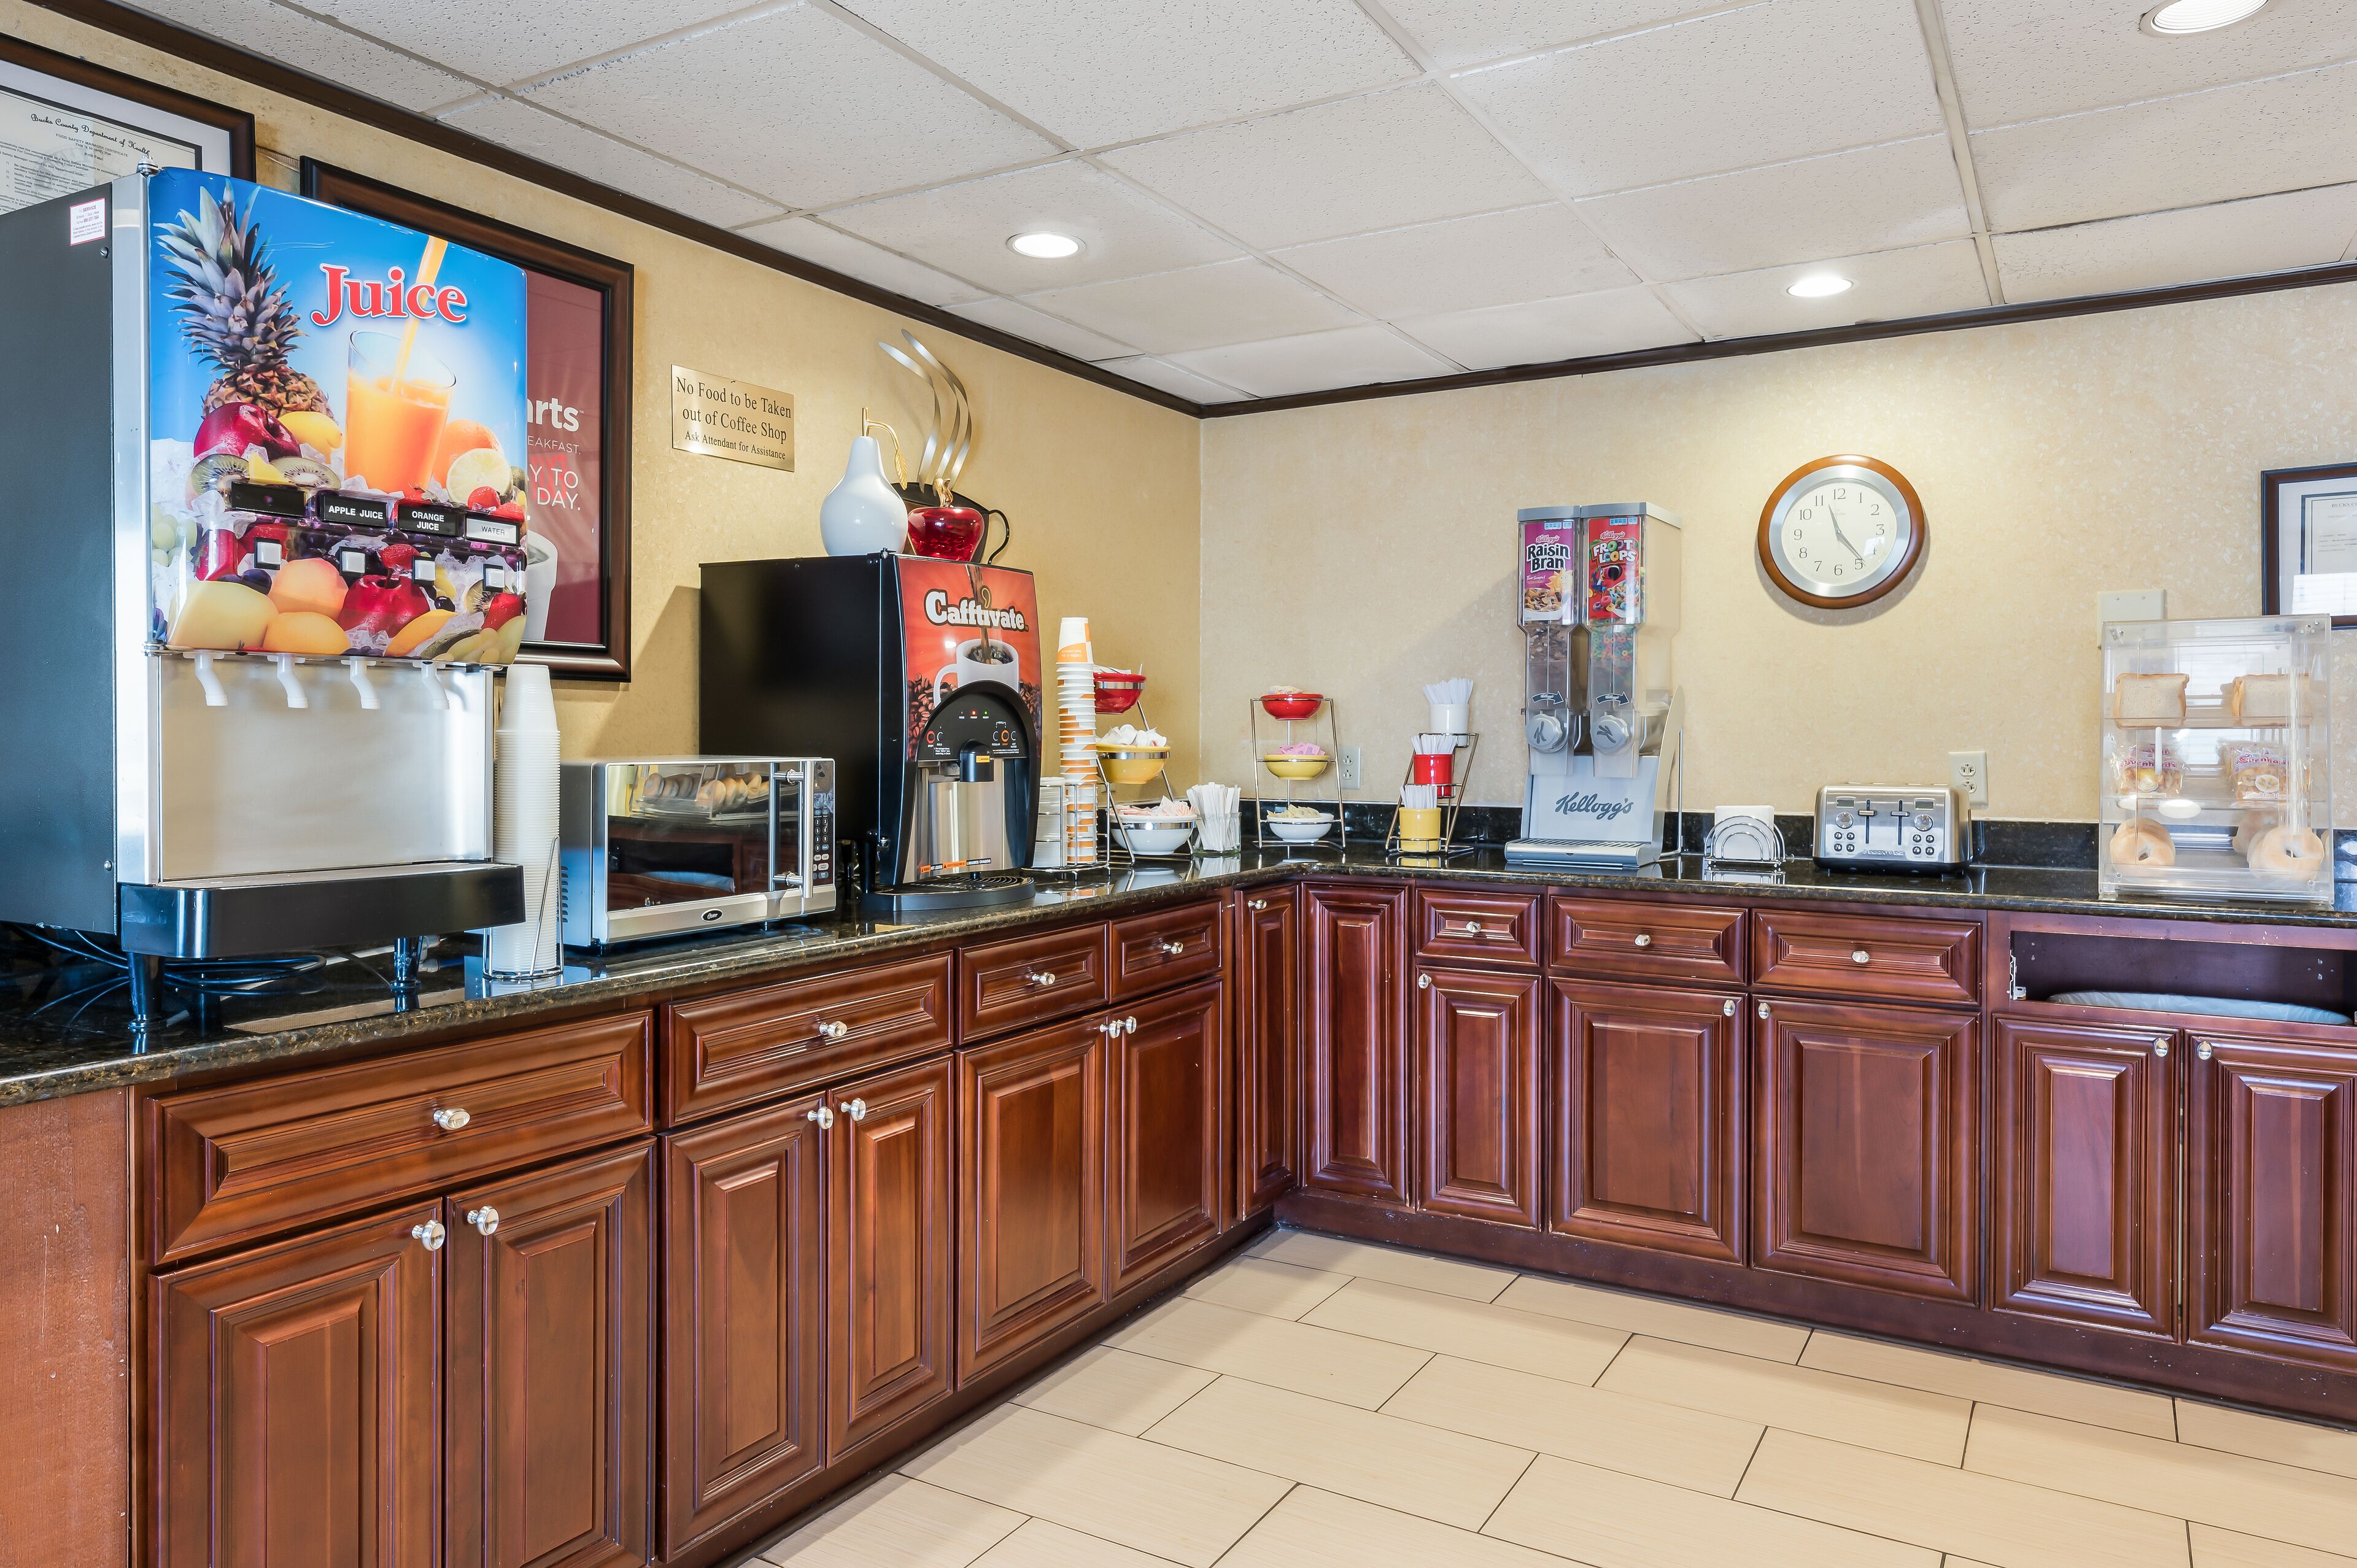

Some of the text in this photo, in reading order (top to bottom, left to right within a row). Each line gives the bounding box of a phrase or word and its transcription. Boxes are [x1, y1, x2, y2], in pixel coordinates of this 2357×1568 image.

[31, 114, 150, 155] Bucks County Department of Health
[311, 263, 468, 326] Juice
[676, 376, 792, 419] No Food to be Taken
[683, 408, 787, 445] out of Coffee Shop
[528, 436, 581, 455] EAKFAST.
[685, 430, 786, 460] Ask Attendant for Assistance
[551, 468, 579, 489] TO
[537, 487, 581, 511] DAY.
[1815, 495, 1824, 506] 11
[1833, 488, 1846, 500] 12
[1859, 492, 1862, 503] 1
[328, 505, 384, 520] APPLE JUICE
[412, 511, 444, 522] ORANGE
[1800, 509, 1812, 520] 10
[1871, 504, 1879, 516] 2
[417, 522, 439, 531] JUICE
[481, 525, 505, 536] WATER
[1875, 523, 1884, 536] 3
[1536, 535, 1560, 544] Kellogg's
[1600, 530, 1625, 540] Kellogg's
[1794, 528, 1802, 541] 9
[1527, 544, 1570, 560] Raisin
[1593, 540, 1633, 557] FROOT
[1799, 547, 1808, 559] 8
[1599, 550, 1636, 563] LOOPS
[1531, 557, 1565, 572] Bran
[1814, 560, 1822, 572] 7
[1834, 564, 1843, 576] 6
[1854, 558, 1863, 570] 5
[1534, 720, 1547, 744] K
[1555, 791, 1634, 820] Kellogg's
